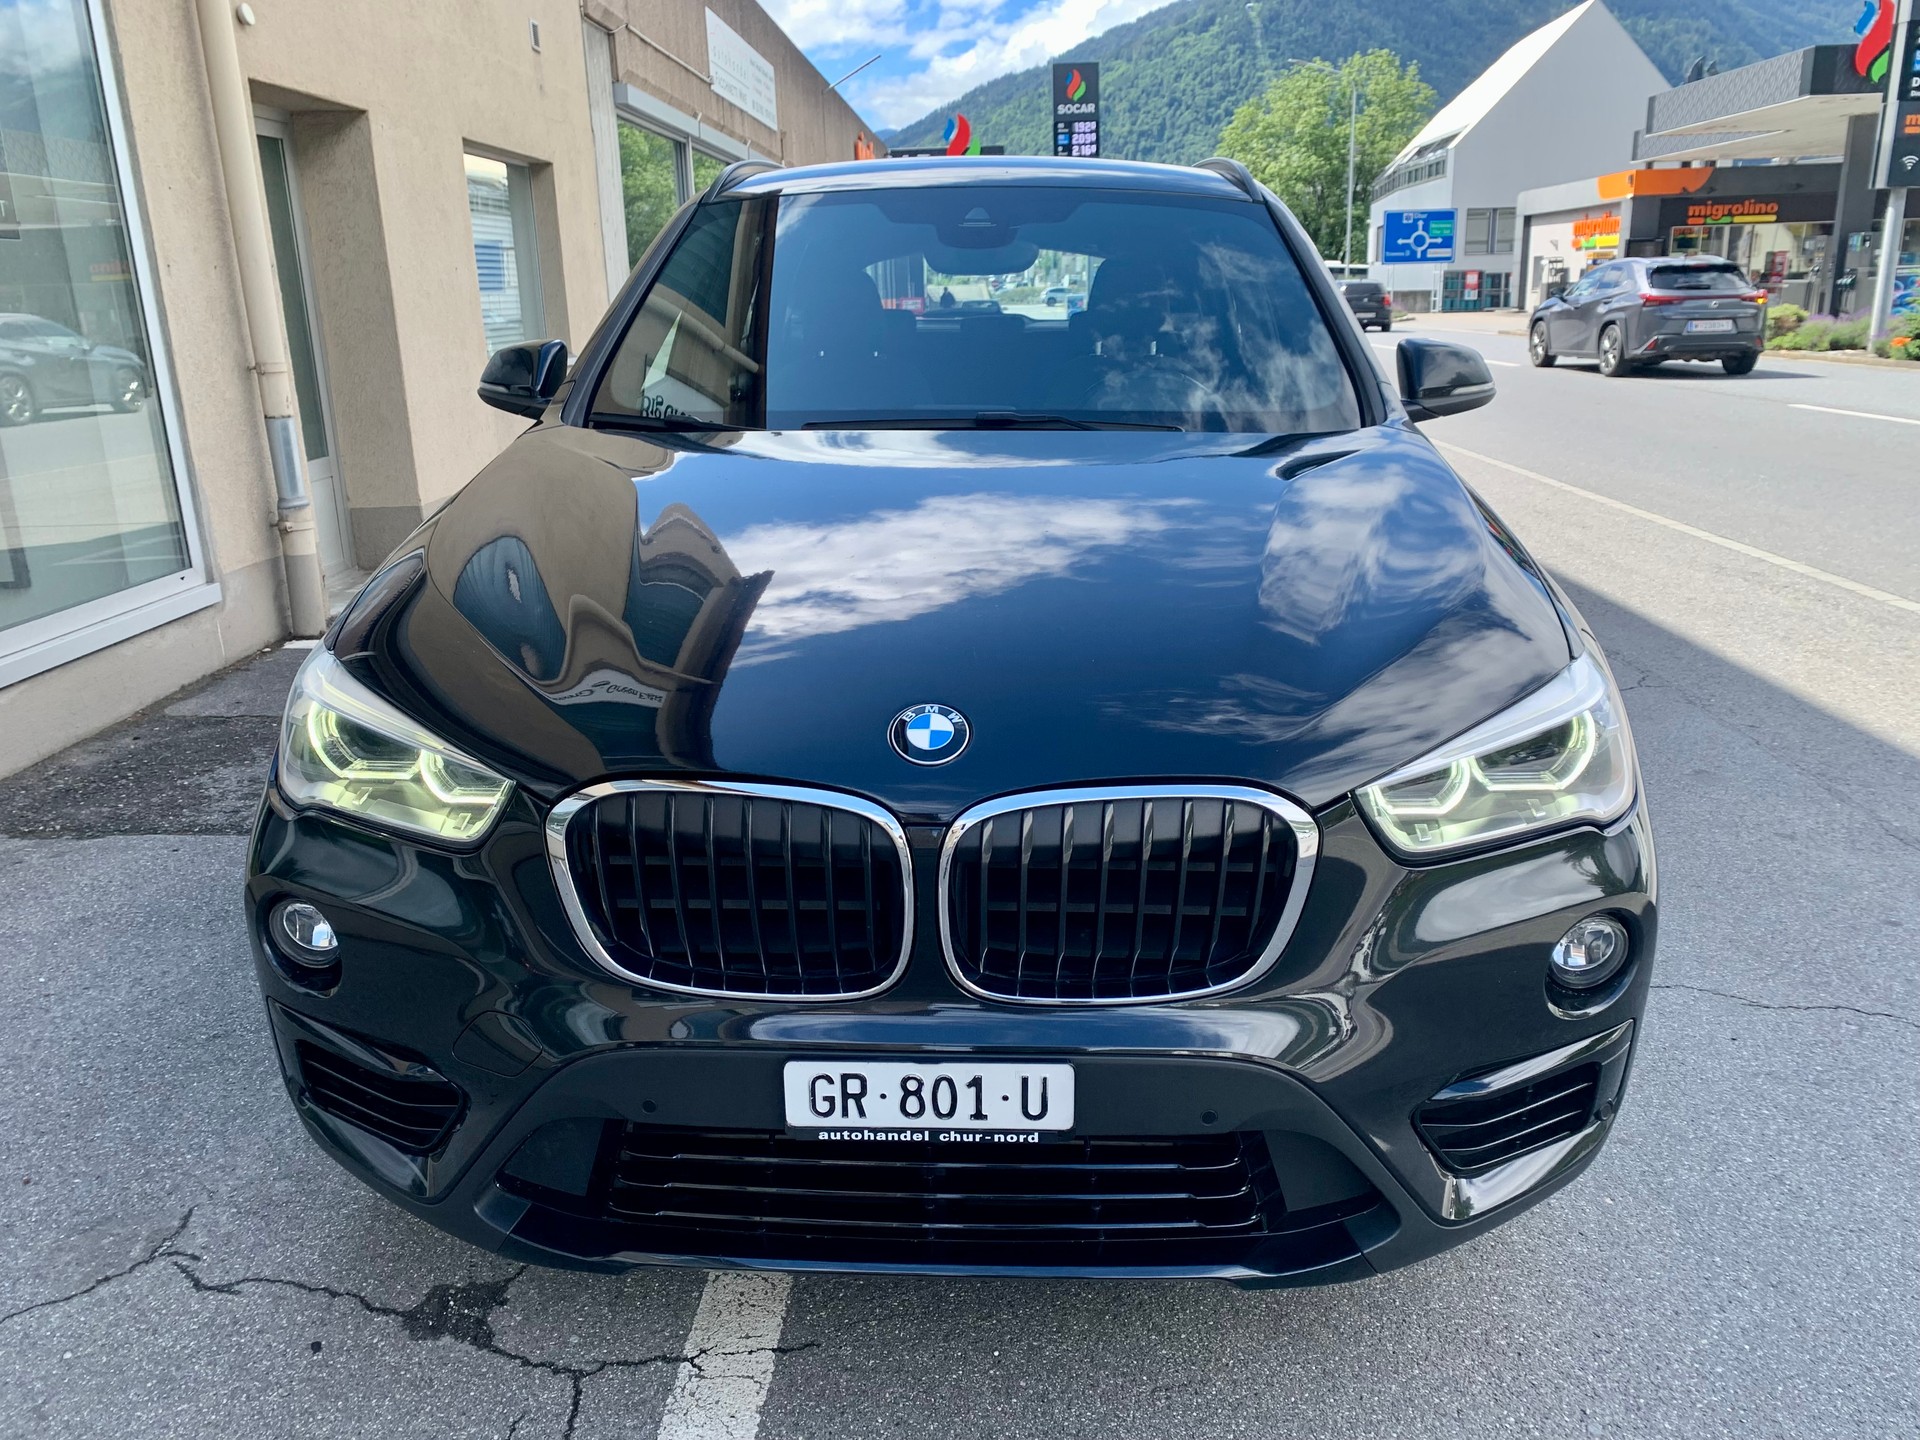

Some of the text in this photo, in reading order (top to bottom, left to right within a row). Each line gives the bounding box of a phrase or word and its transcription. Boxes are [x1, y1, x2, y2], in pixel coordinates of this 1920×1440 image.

[1057, 103, 1096, 115] SOCAR
[1688, 199, 1779, 220] migrolino
[901, 705, 963, 724] BMW
[818, 1130, 1039, 1143] autohandel chur-nord
